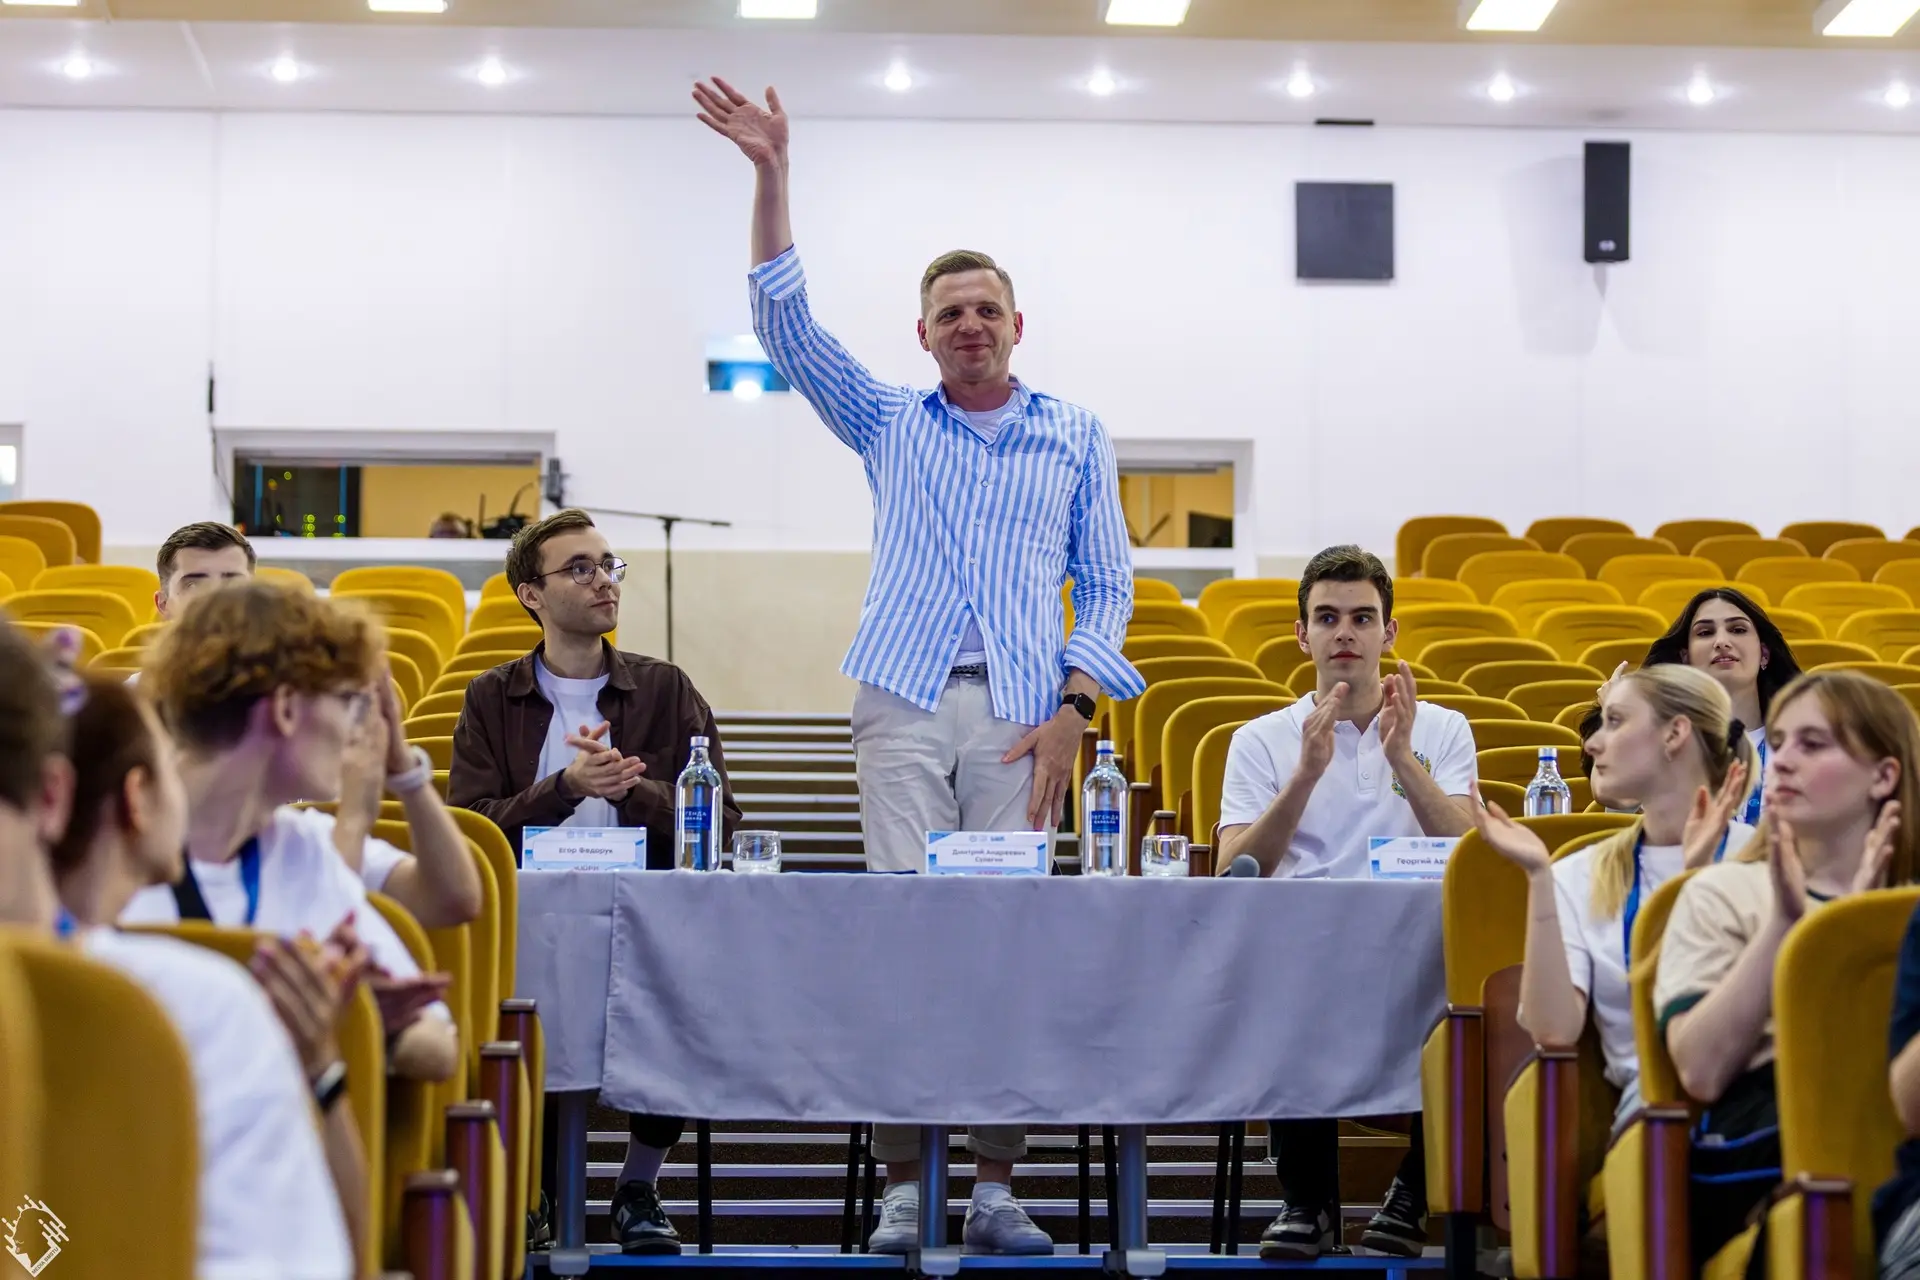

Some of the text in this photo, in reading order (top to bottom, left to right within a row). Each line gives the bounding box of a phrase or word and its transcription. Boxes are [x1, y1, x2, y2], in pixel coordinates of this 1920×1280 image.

[579, 847, 613, 855] Федорук
[986, 849, 1026, 857] Андреевич
[1397, 857, 1432, 866] Георгий
